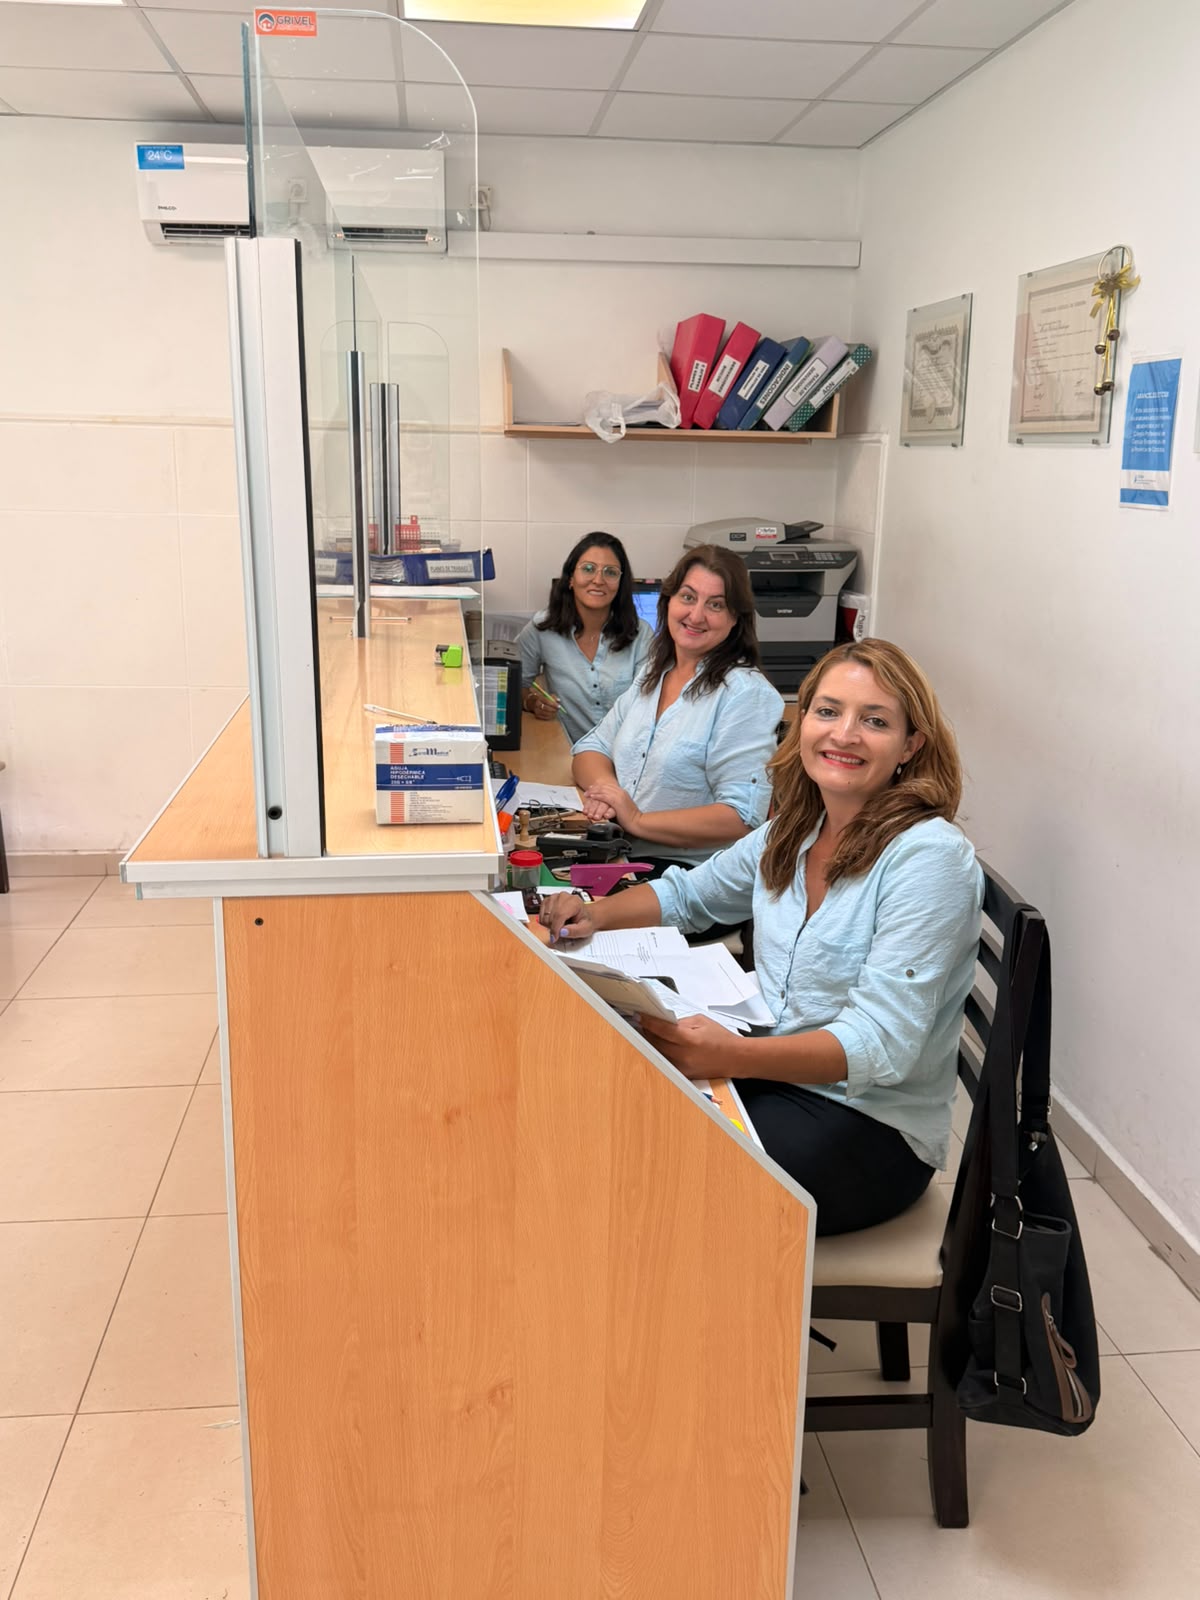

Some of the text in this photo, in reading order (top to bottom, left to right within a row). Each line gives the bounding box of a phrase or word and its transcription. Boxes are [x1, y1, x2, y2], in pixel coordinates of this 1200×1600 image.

[276, 15, 315, 26] GRIVEL
[147, 150, 173, 161] 24°C
[760, 362, 791, 405] INDICACIONES
